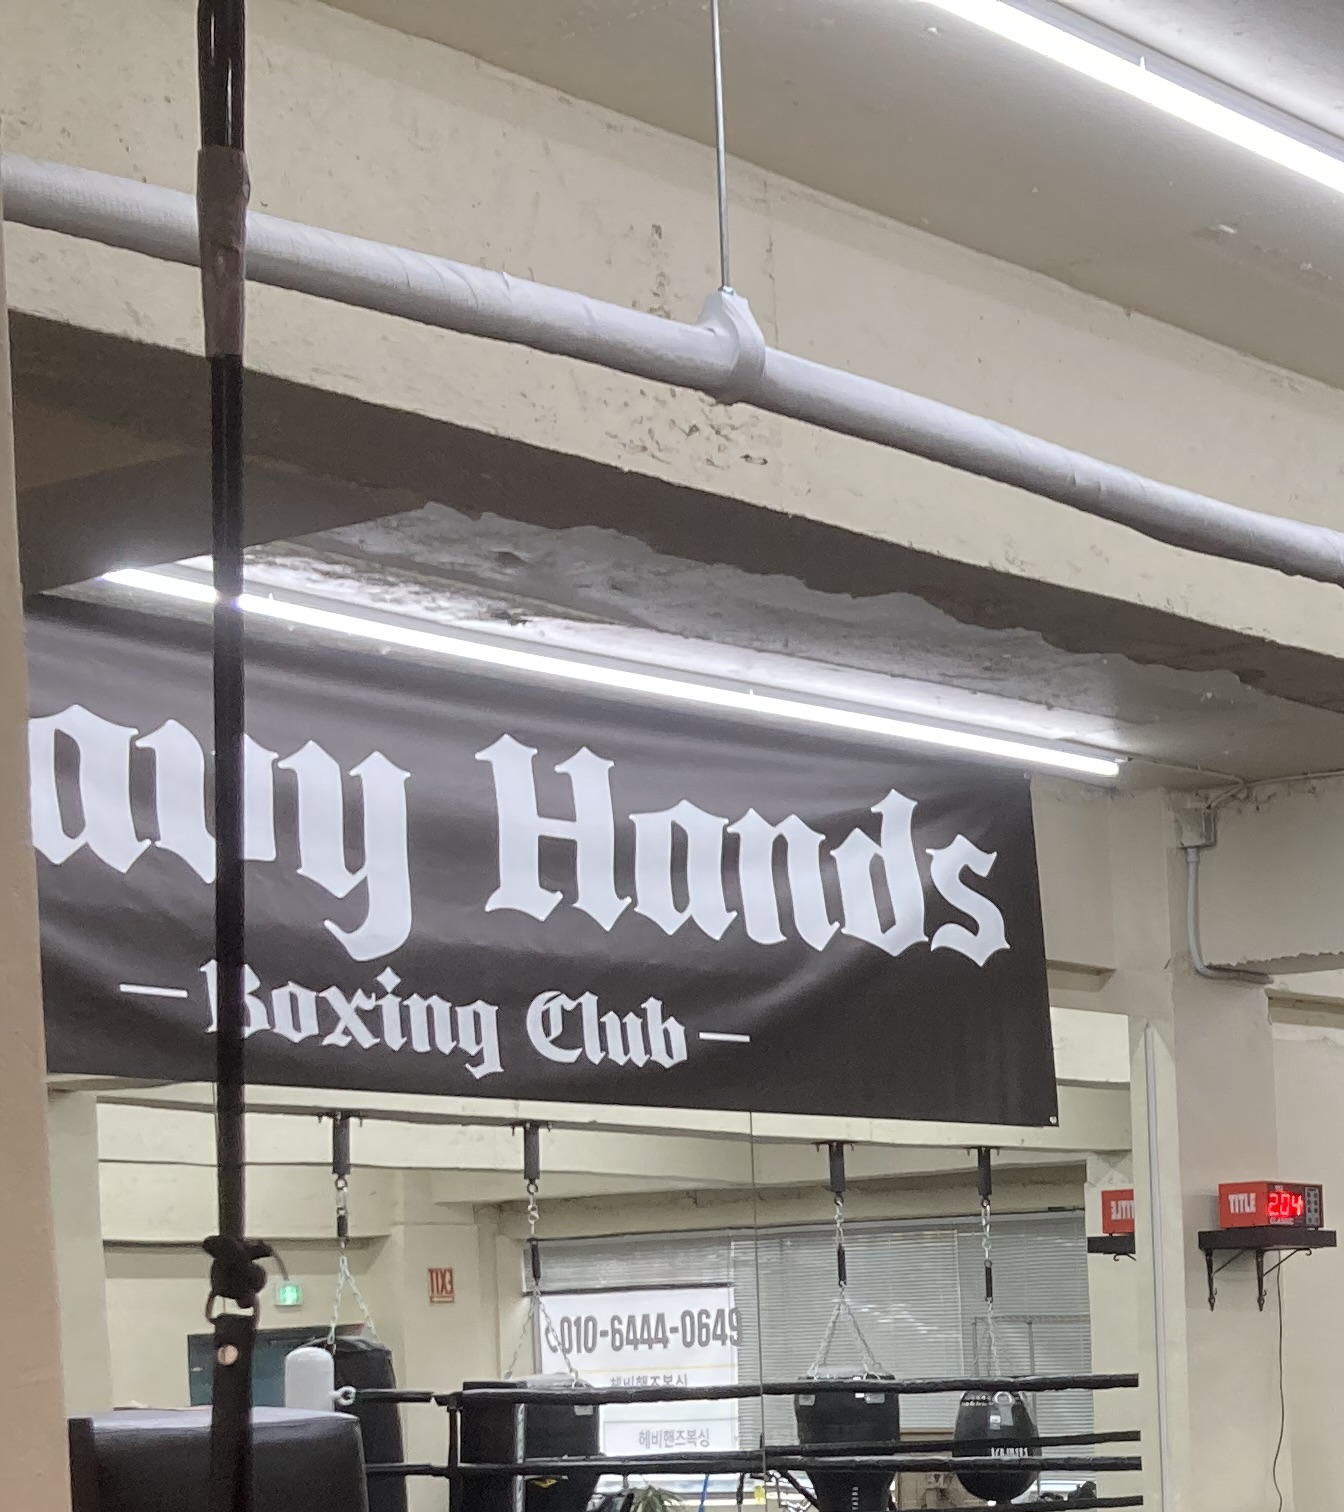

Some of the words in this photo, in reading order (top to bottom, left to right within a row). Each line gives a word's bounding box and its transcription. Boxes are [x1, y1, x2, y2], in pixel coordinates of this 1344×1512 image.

[474, 733, 1012, 967] Hands
[526, 986, 689, 1069] Club
[1228, 1193, 1257, 1215] TITLE
